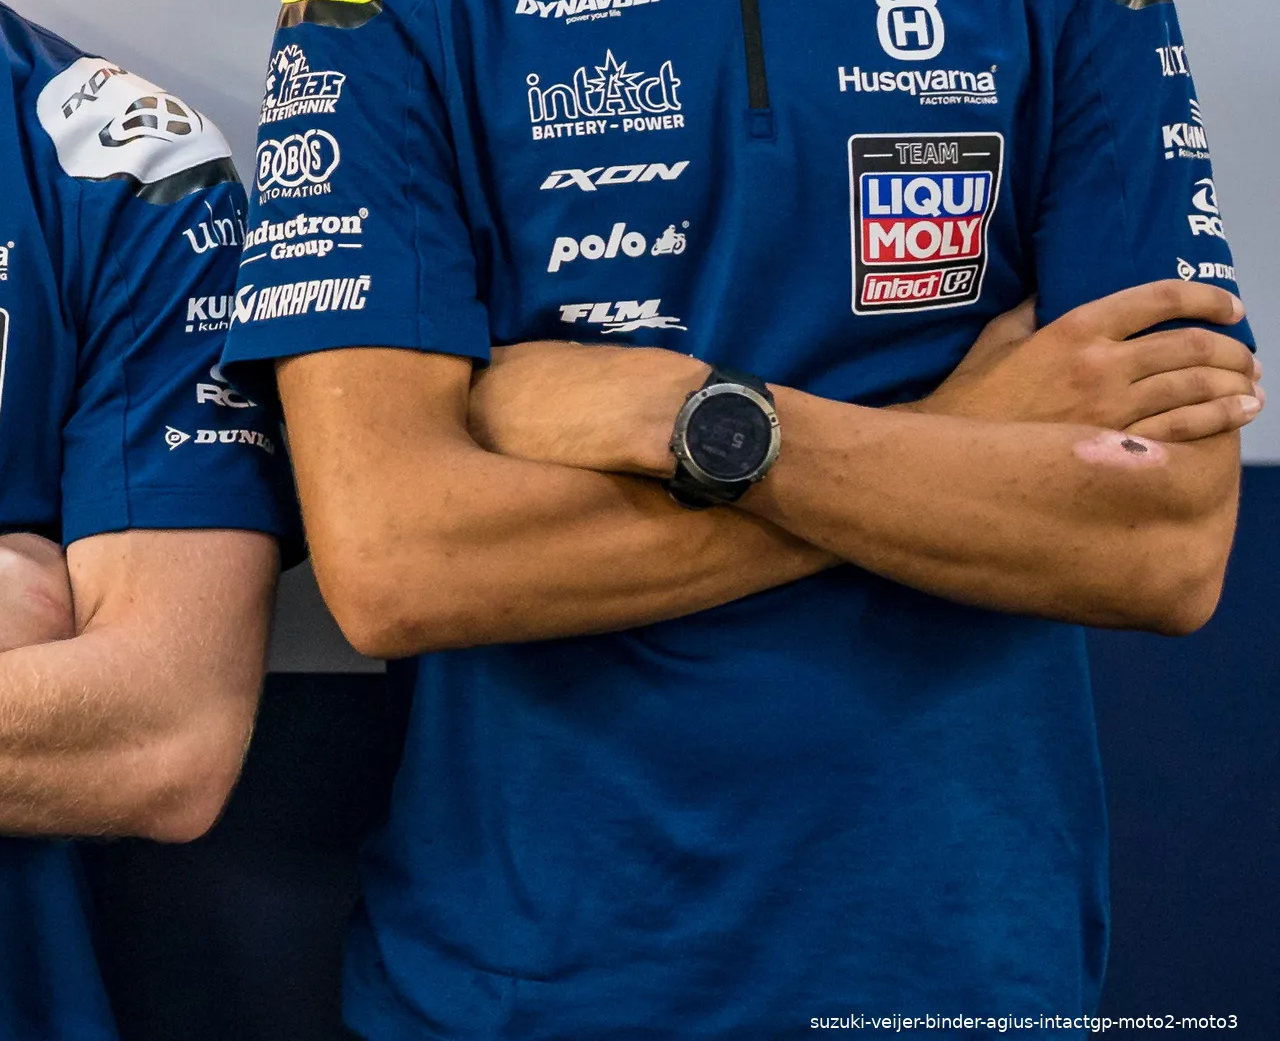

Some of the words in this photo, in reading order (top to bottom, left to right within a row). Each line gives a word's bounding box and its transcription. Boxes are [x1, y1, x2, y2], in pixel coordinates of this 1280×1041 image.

[838, 66, 994, 100] Husqvarna
[920, 95, 962, 106] FACTORY
[963, 95, 998, 106] RACING
[533, 119, 609, 140] BATTERY
[623, 113, 685, 133] POWER
[895, 141, 959, 166] TEAM
[867, 176, 985, 218] LIQUI
[270, 239, 334, 260] Group
[547, 222, 647, 273] polo
[868, 217, 981, 260] MOLY
[559, 298, 662, 325] FLM
